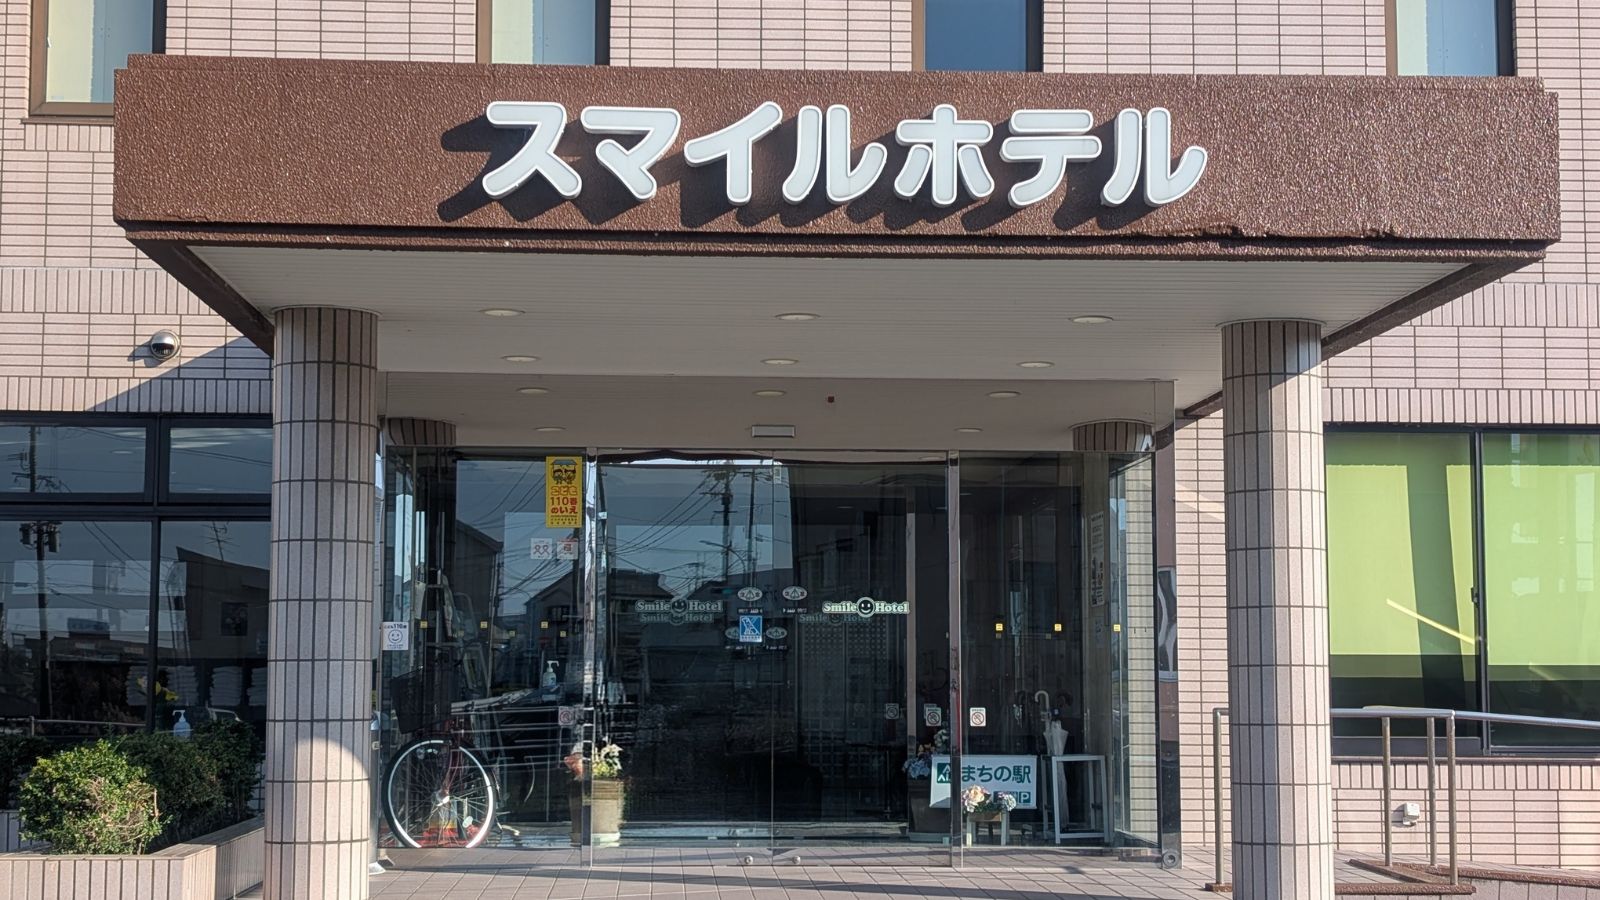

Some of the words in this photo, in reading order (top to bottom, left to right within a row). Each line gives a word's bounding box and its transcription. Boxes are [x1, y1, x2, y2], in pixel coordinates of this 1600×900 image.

[482, 100, 1209, 208] スマイルホテル
[550, 486, 578, 496] こども
[550, 496, 578, 506] 110番
[550, 506, 578, 514] のいえ
[635, 600, 671, 612] Smile
[688, 600, 723, 612] Hotel
[822, 601, 858, 613] Smile
[875, 601, 910, 614] Hotel
[961, 765, 1031, 783] まちの駅
